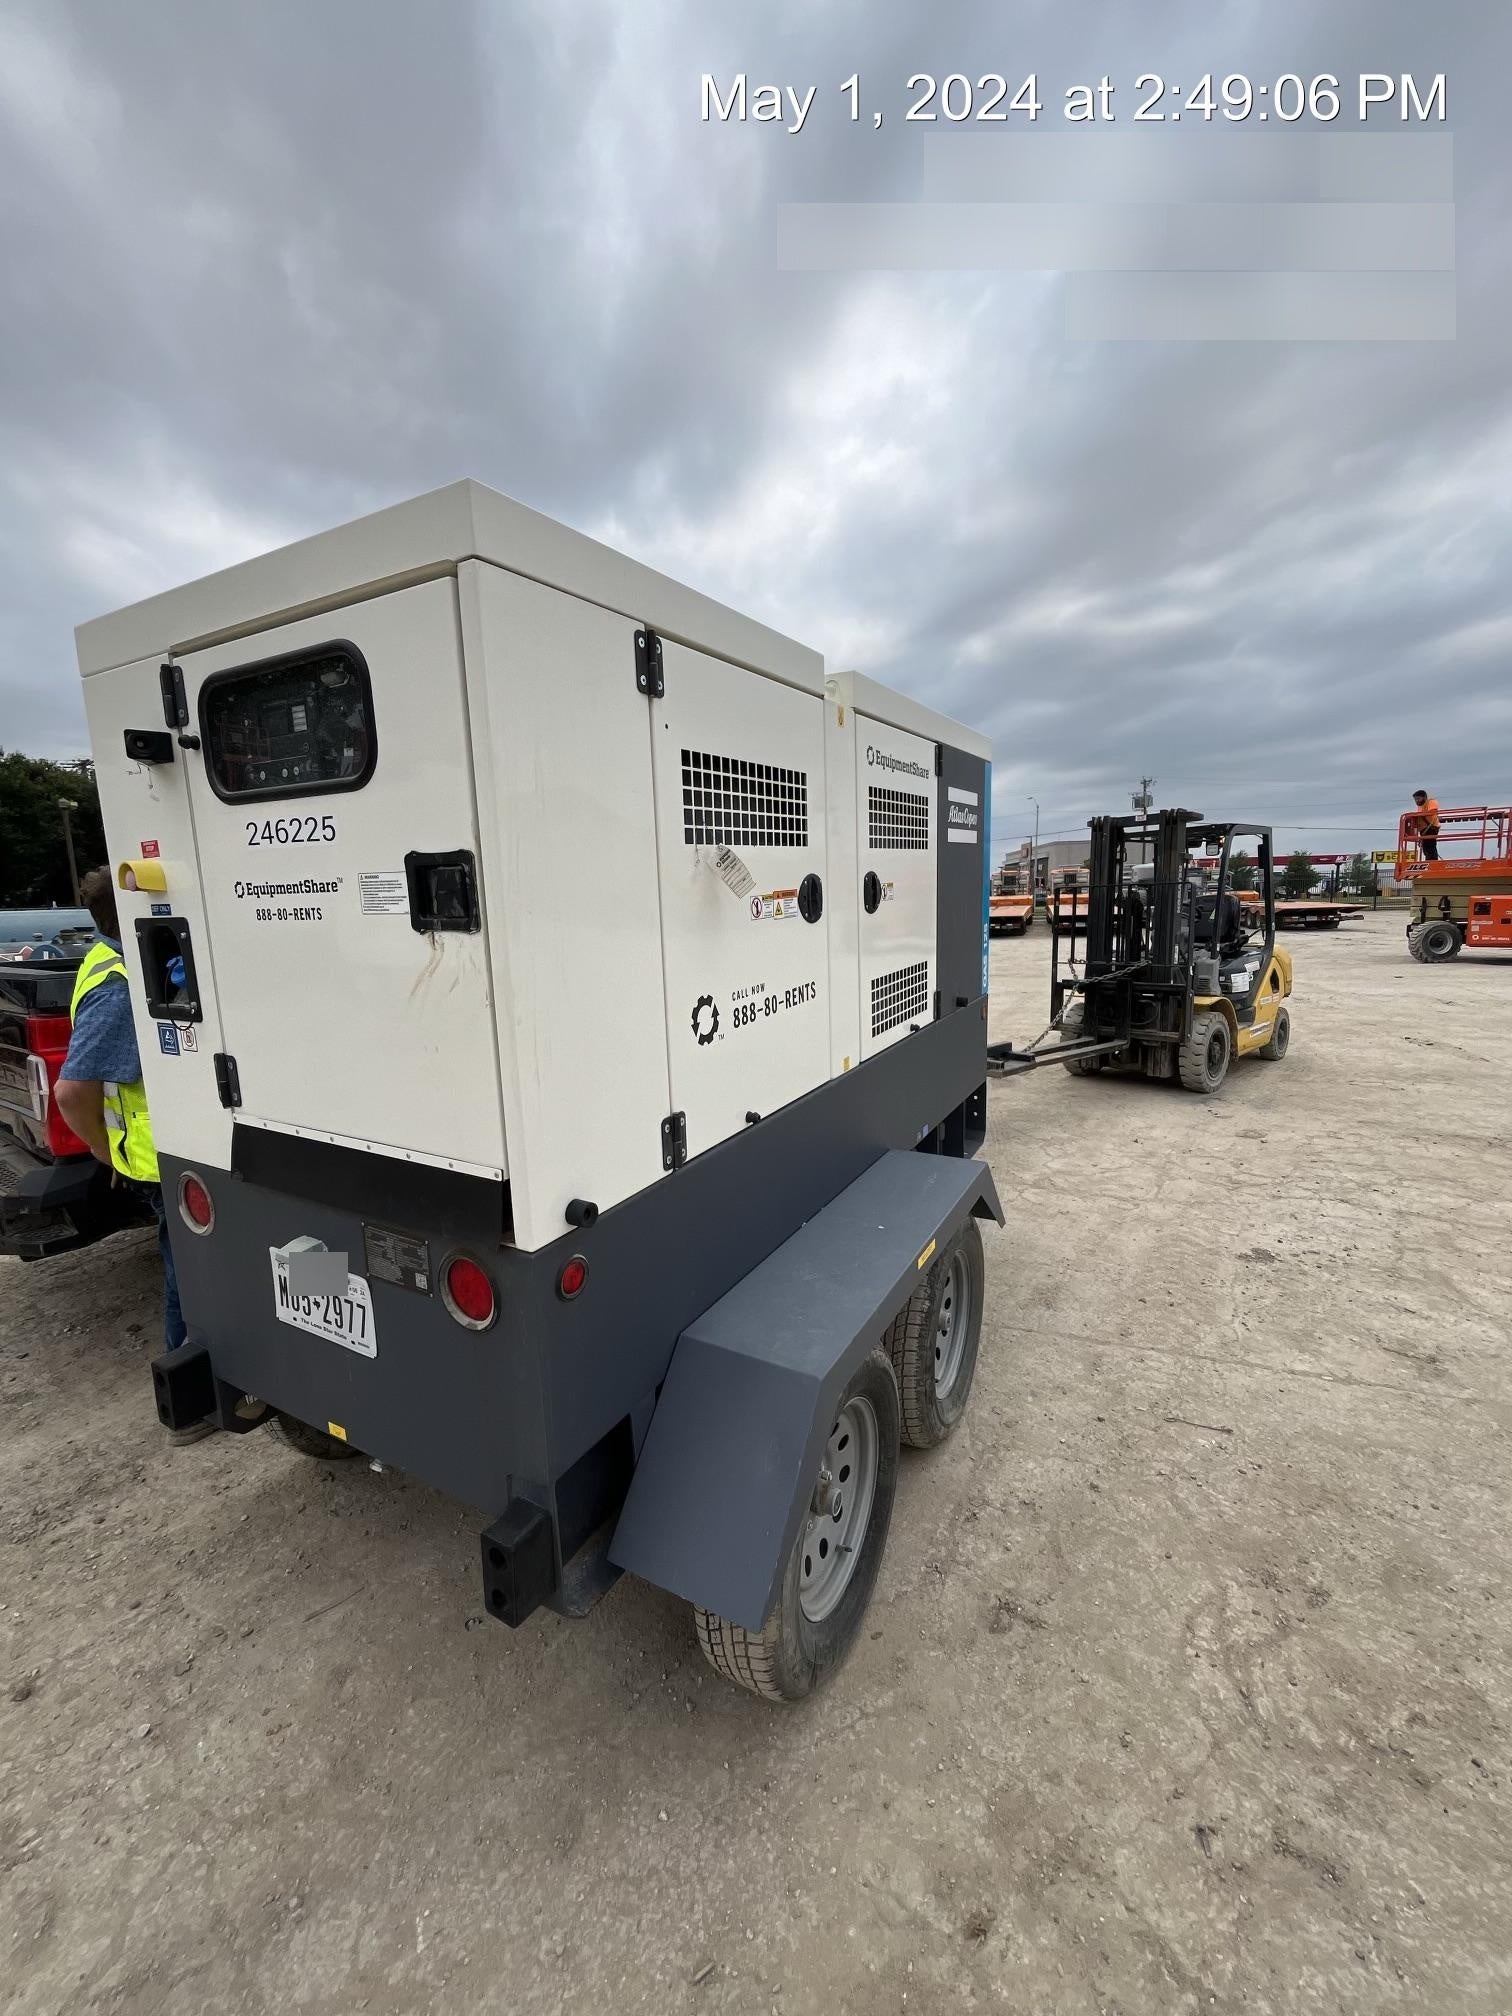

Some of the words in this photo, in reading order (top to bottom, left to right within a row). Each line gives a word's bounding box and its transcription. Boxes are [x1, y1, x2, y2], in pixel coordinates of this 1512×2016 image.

[876, 750, 930, 779] EquipmentShare
[246, 815, 336, 846] 246225
[1406, 863, 1429, 871] JLG
[246, 879, 338, 899] EquipmentShare
[256, 907, 323, 921] 888-80-RENTS
[732, 988, 749, 1002] CALL
[751, 983, 766, 995] NOW
[733, 981, 816, 1028] 888-80-RENTS
